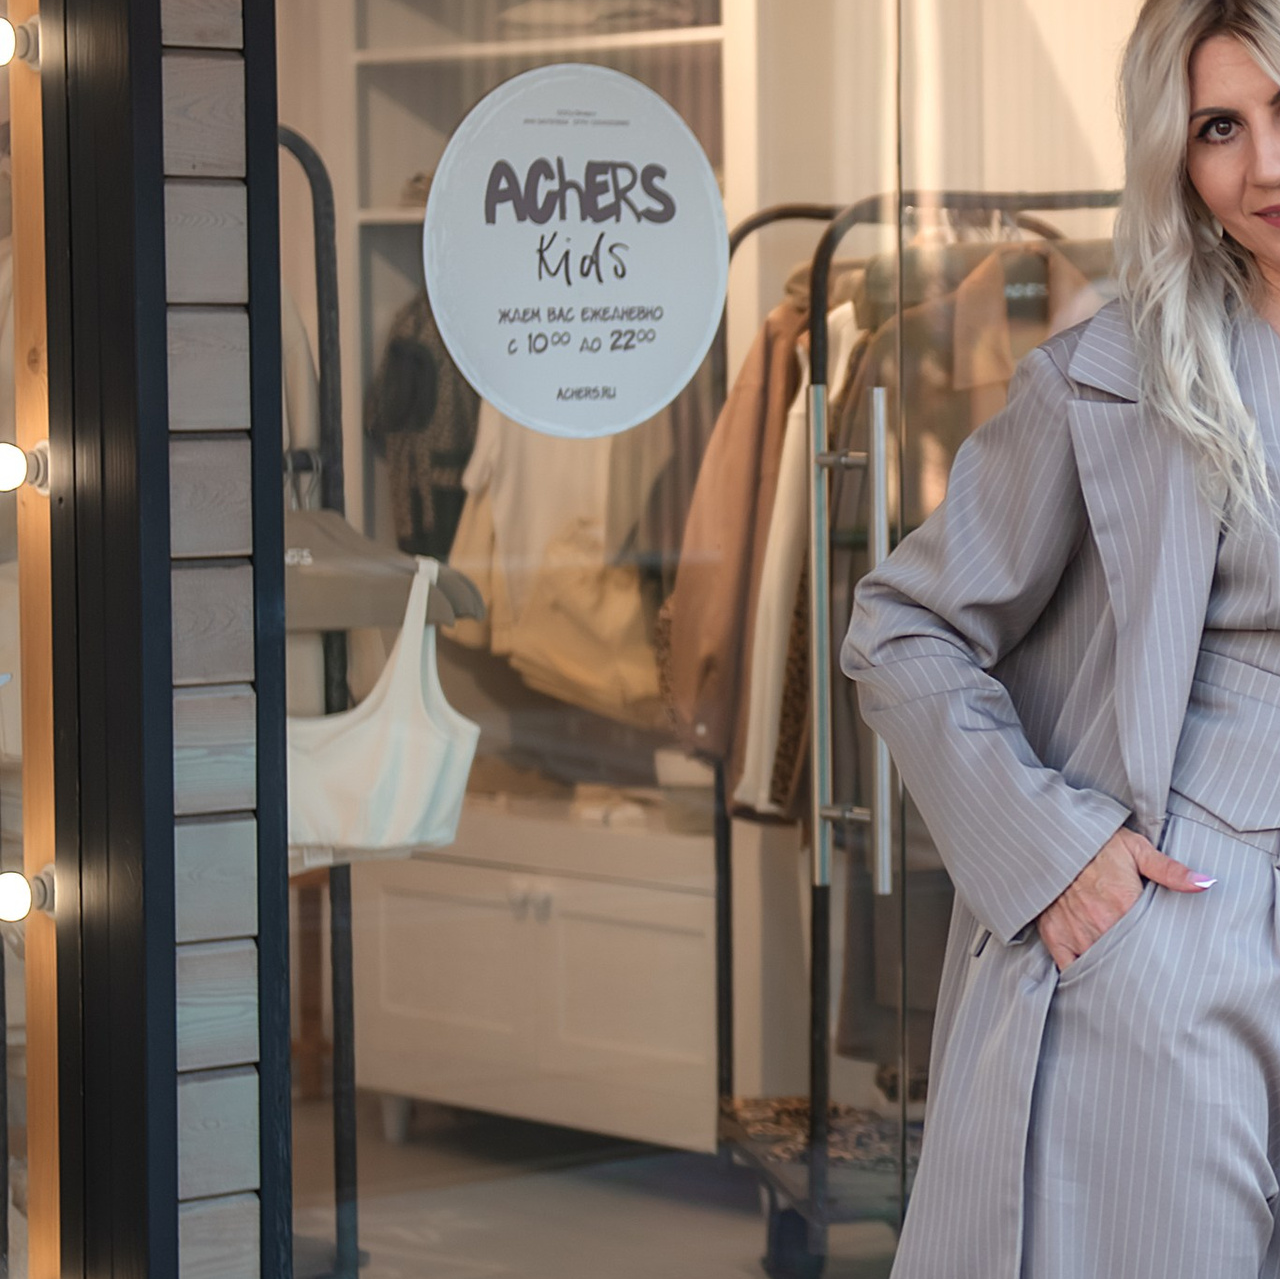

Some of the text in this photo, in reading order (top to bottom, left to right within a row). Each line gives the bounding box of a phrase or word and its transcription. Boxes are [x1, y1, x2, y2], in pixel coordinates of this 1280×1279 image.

[536, 231, 629, 286] Kids
[498, 305, 664, 325] ЖДЕМ ВАС ЕЖЕДНЕВНО
